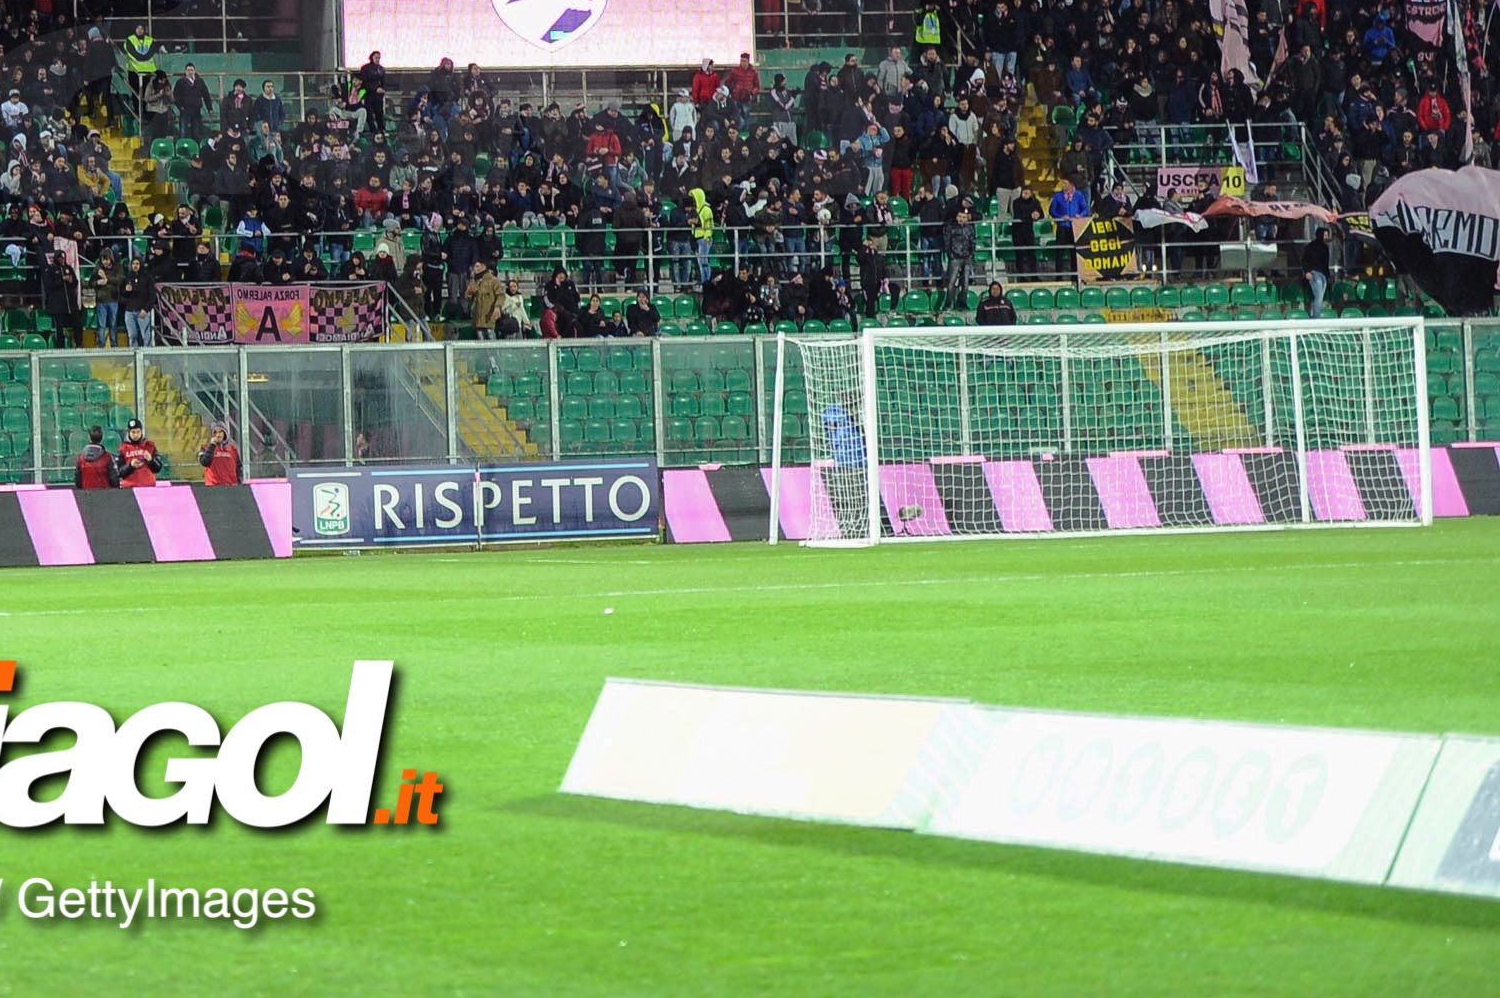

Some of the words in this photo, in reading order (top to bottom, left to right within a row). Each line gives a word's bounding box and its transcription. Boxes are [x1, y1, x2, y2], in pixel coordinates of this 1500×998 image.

[1159, 173, 1219, 187] USCITA
[1223, 175, 1242, 189] 10
[1090, 219, 1118, 236] IERI
[1089, 237, 1121, 251] OGGI
[319, 519, 345, 530] LNPB
[373, 475, 651, 530] RISPETTO
